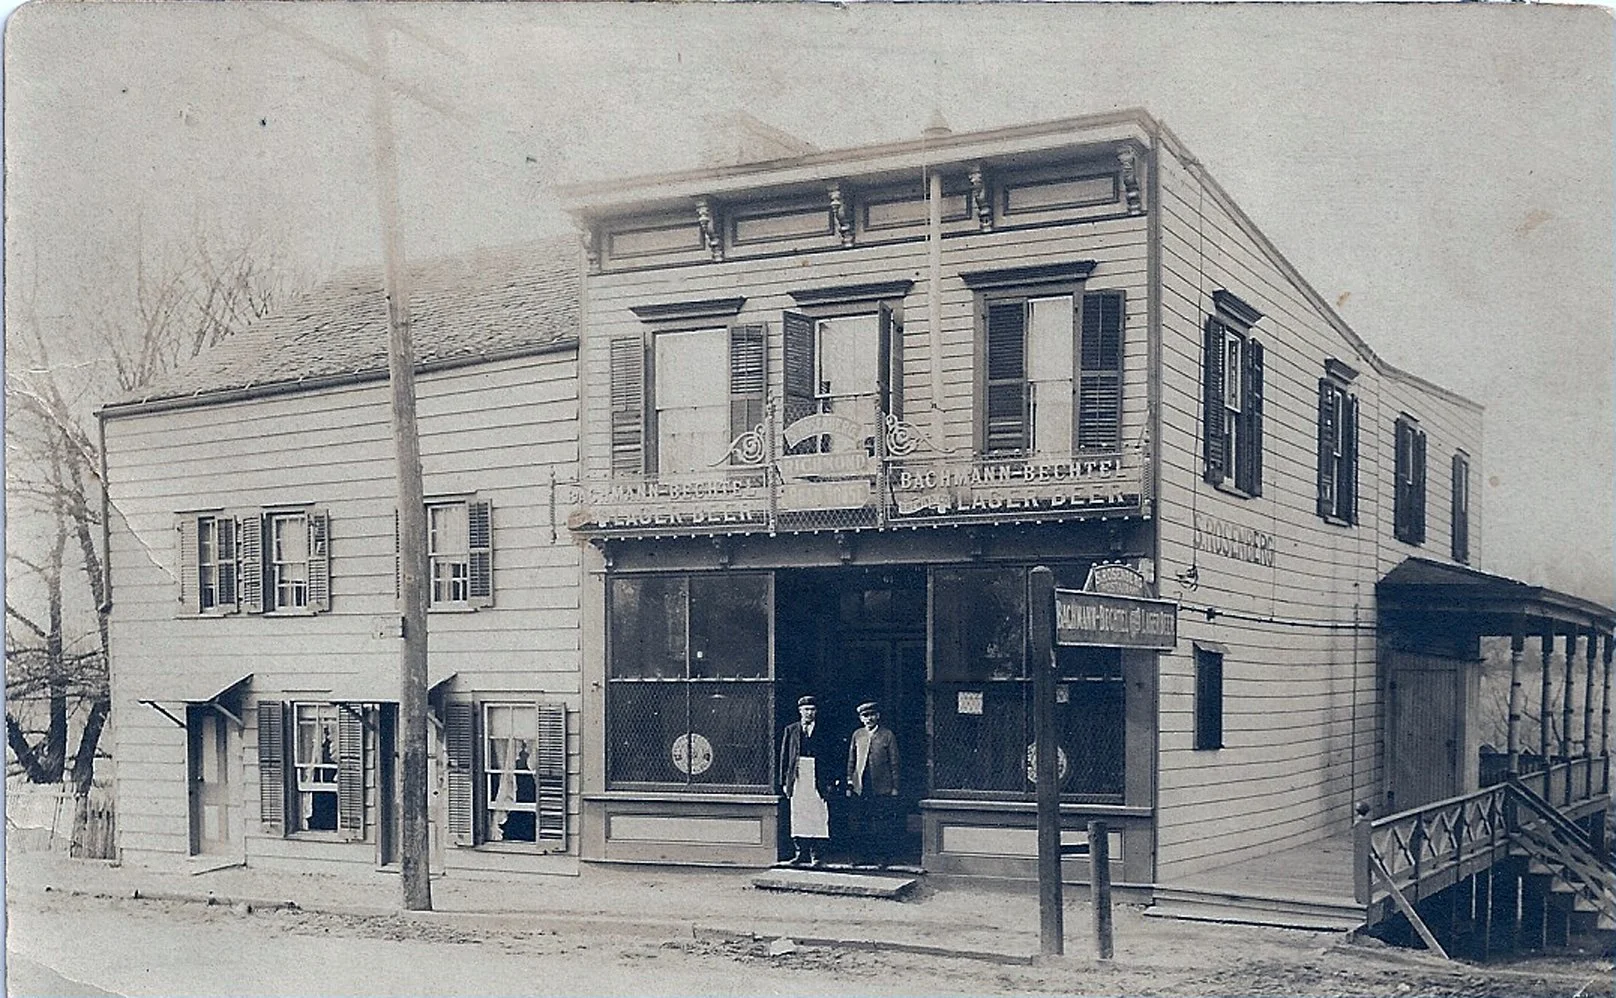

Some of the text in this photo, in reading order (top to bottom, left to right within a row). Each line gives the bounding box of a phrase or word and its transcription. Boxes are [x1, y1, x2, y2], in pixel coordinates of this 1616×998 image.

[900, 460, 1126, 489] BACHMANN-BECHTEL
[956, 486, 1039, 511] LAGER
[1051, 481, 1124, 506] BEER
[613, 502, 753, 526] LAGER BEER
